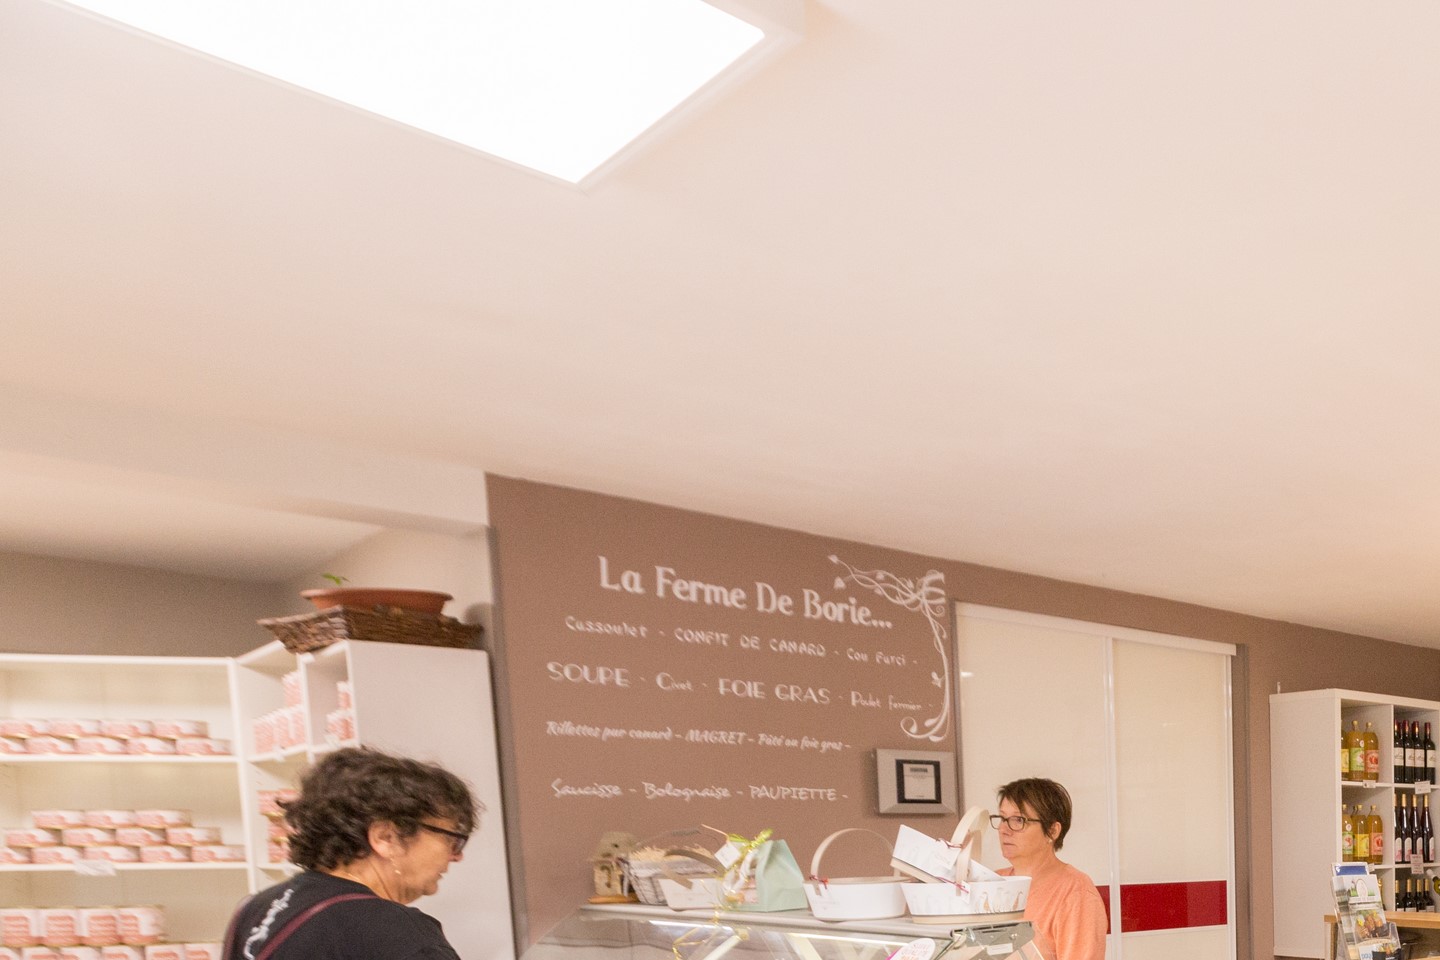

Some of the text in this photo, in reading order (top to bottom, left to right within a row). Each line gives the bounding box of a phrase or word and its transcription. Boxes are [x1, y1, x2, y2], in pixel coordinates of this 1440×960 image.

[598, 555, 645, 595] La
[655, 565, 747, 610] Ferme
[755, 581, 794, 616] De
[565, 615, 648, 638] Cassoulet
[674, 627, 729, 647] CONFIT
[740, 634, 760, 650] DE
[769, 638, 827, 658] CANARD
[847, 648, 868, 663] Cou
[547, 662, 630, 688] SOUPE
[656, 672, 693, 691] Civet
[718, 678, 767, 699] FOIE
[774, 684, 831, 705] GRAS
[851, 691, 881, 708] Poulet
[546, 720, 600, 738] Rillettes
[629, 726, 674, 741] canard
[685, 729, 747, 745] MAGRET
[551, 777, 838, 803] Saucisse Bolognaise PAUPIETTE
